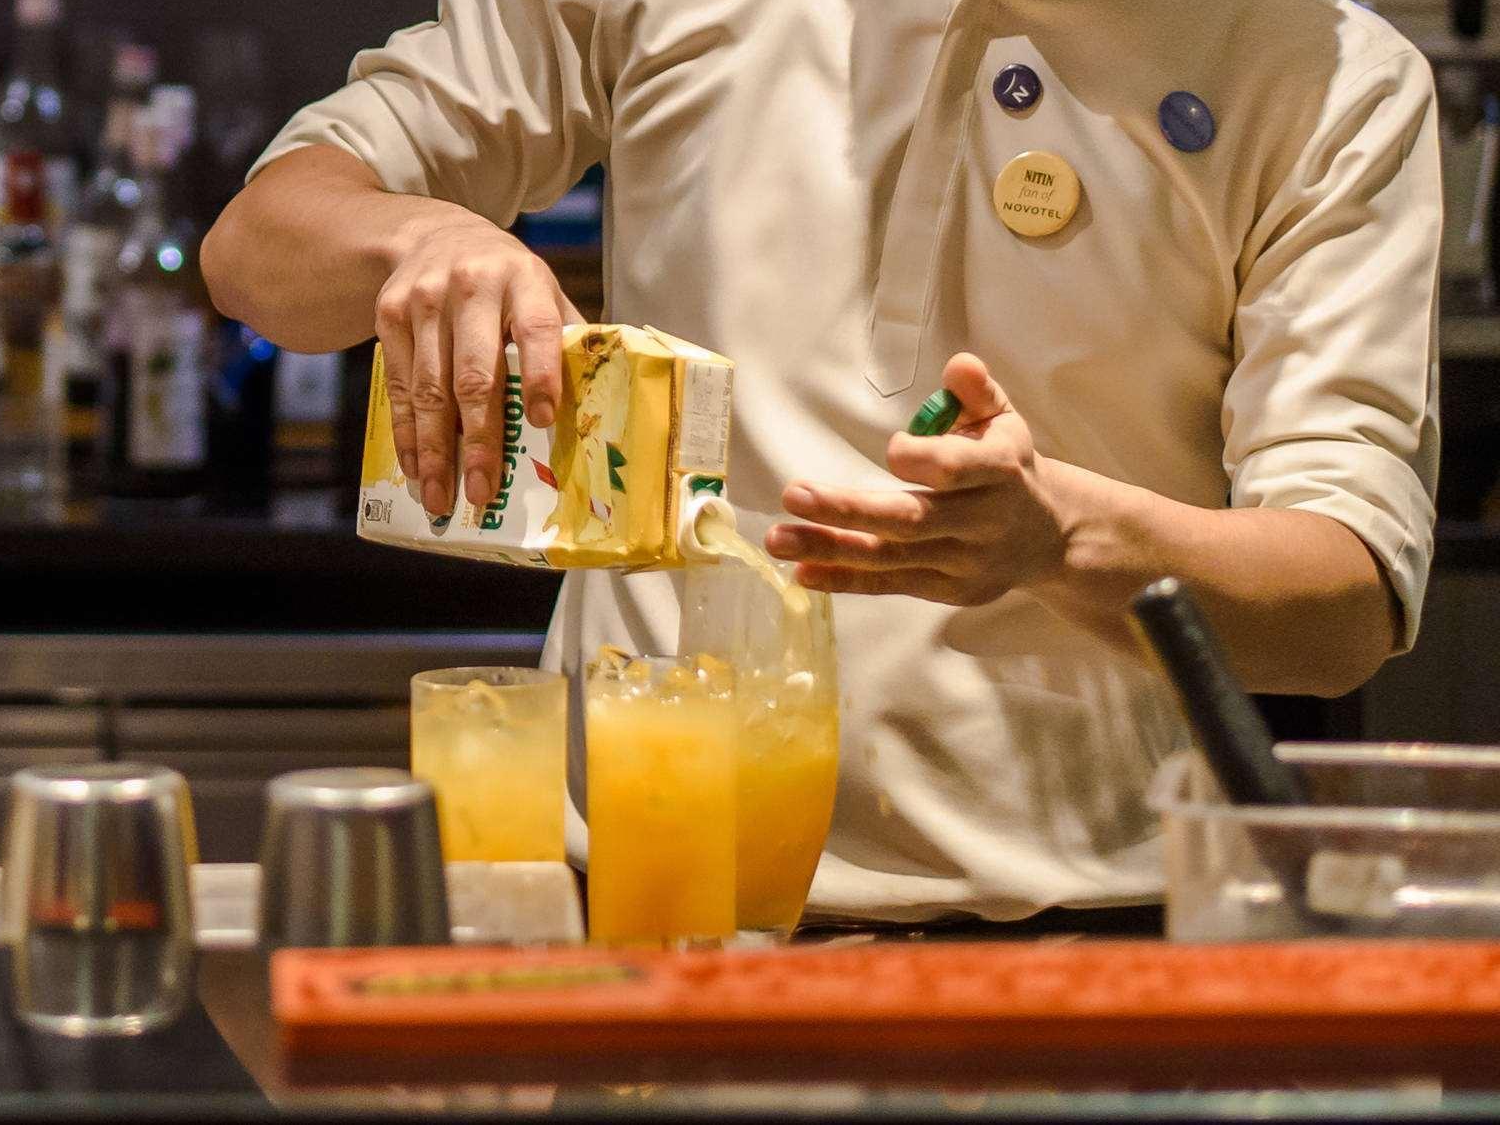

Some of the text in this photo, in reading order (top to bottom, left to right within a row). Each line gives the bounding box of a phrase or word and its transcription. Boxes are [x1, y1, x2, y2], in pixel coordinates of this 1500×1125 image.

[1024, 169, 1055, 187] NITIN
[1018, 186, 1055, 203] fan of
[1003, 202, 1062, 219] NOVOTEL
